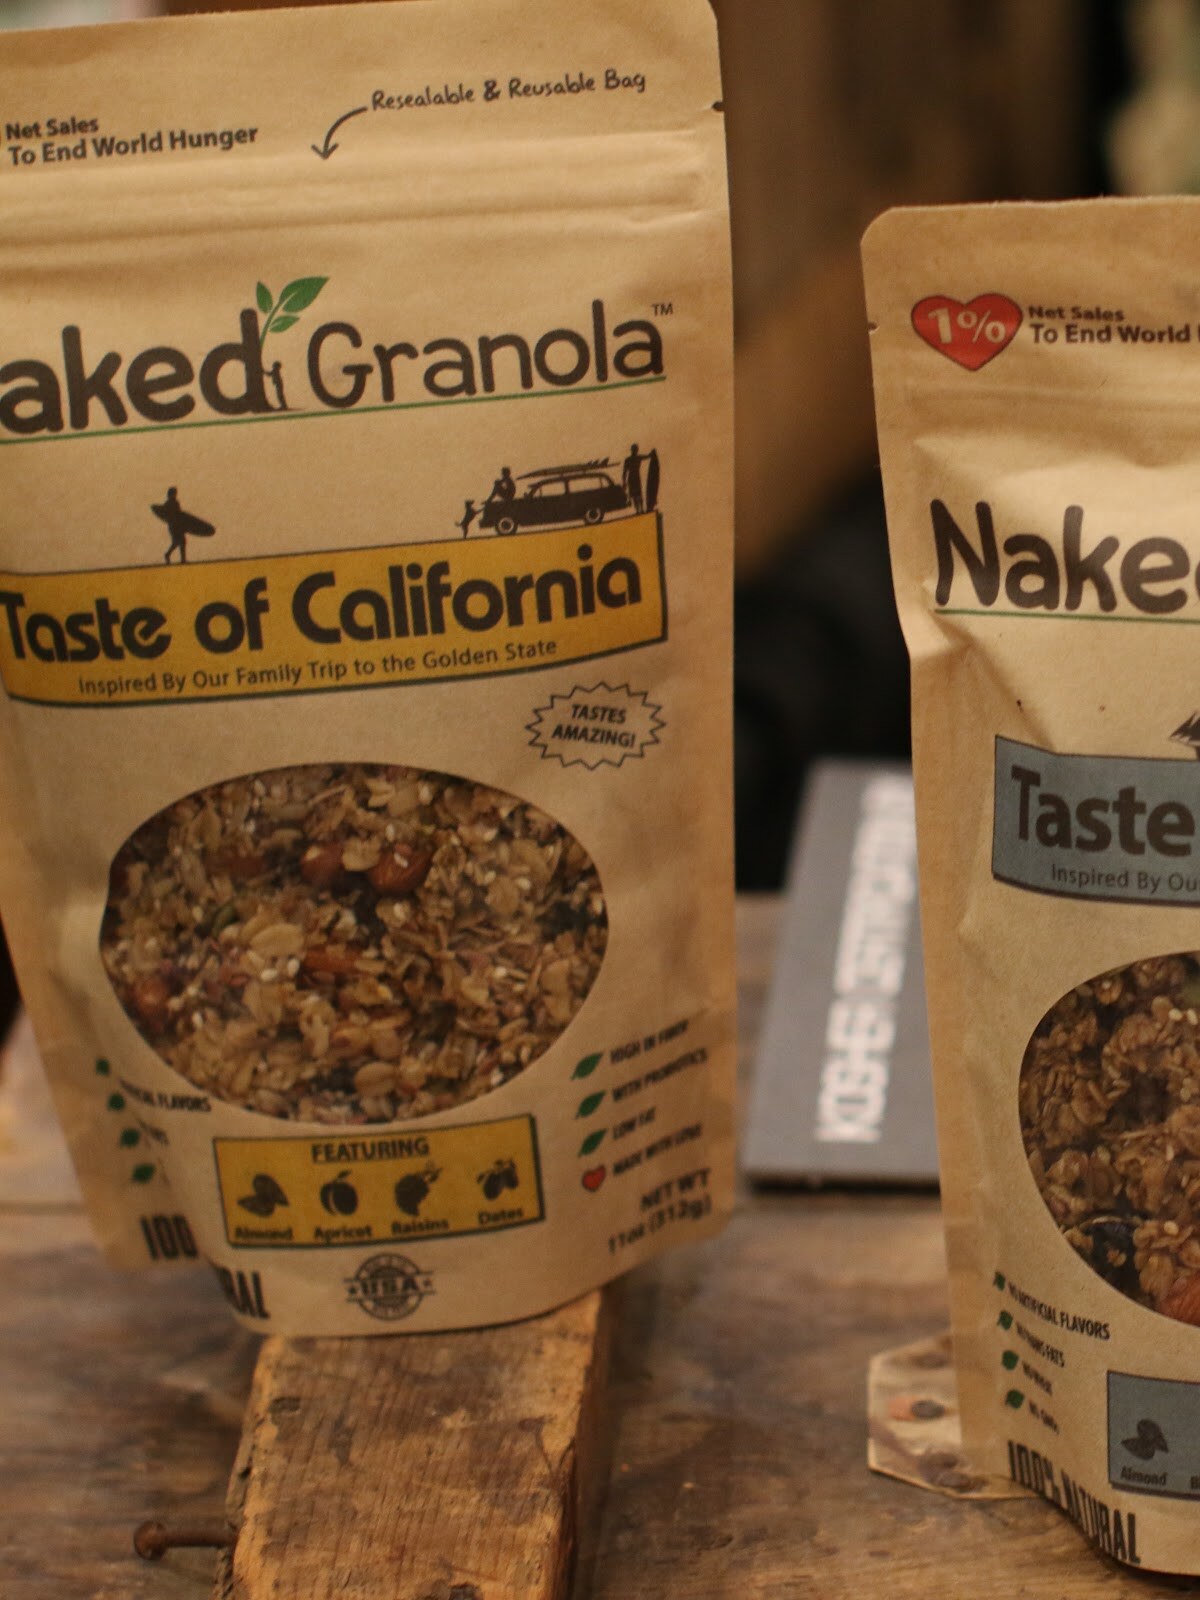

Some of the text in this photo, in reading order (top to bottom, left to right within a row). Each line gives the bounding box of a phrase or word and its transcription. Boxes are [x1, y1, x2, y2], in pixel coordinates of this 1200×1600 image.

[372, 68, 646, 110] Resealable & Reusable Bag
[5, 116, 99, 140] Net Sales
[9, 127, 258, 166] To End World Hunger
[928, 307, 1006, 345] 1%
[1028, 305, 1124, 322] Net Sales
[1030, 323, 1059, 344] To
[1065, 323, 1112, 344] End
[1117, 323, 1191, 344] World
[0, 308, 267, 434] aked
[307, 299, 664, 409] Granola
[3, 543, 642, 662] Taste of California
[78, 638, 558, 699] Inspired By Our Family Trip to the Golden State
[571, 703, 627, 724] TASTES
[550, 724, 635, 748] AMAZING!
[1011, 764, 1196, 858] Taste
[1051, 863, 1129, 890] Inspired
[1137, 871, 1160, 894] By
[312, 1136, 430, 1163] FEATURING
[640, 1167, 711, 1212] NET WT
[314, 1224, 373, 1243] Apricot
[391, 1217, 449, 1235] Raisins
[478, 1205, 523, 1224] Dates
[1060, 1310, 1111, 1341] FLAVORS
[1120, 1466, 1168, 1486] Almond
